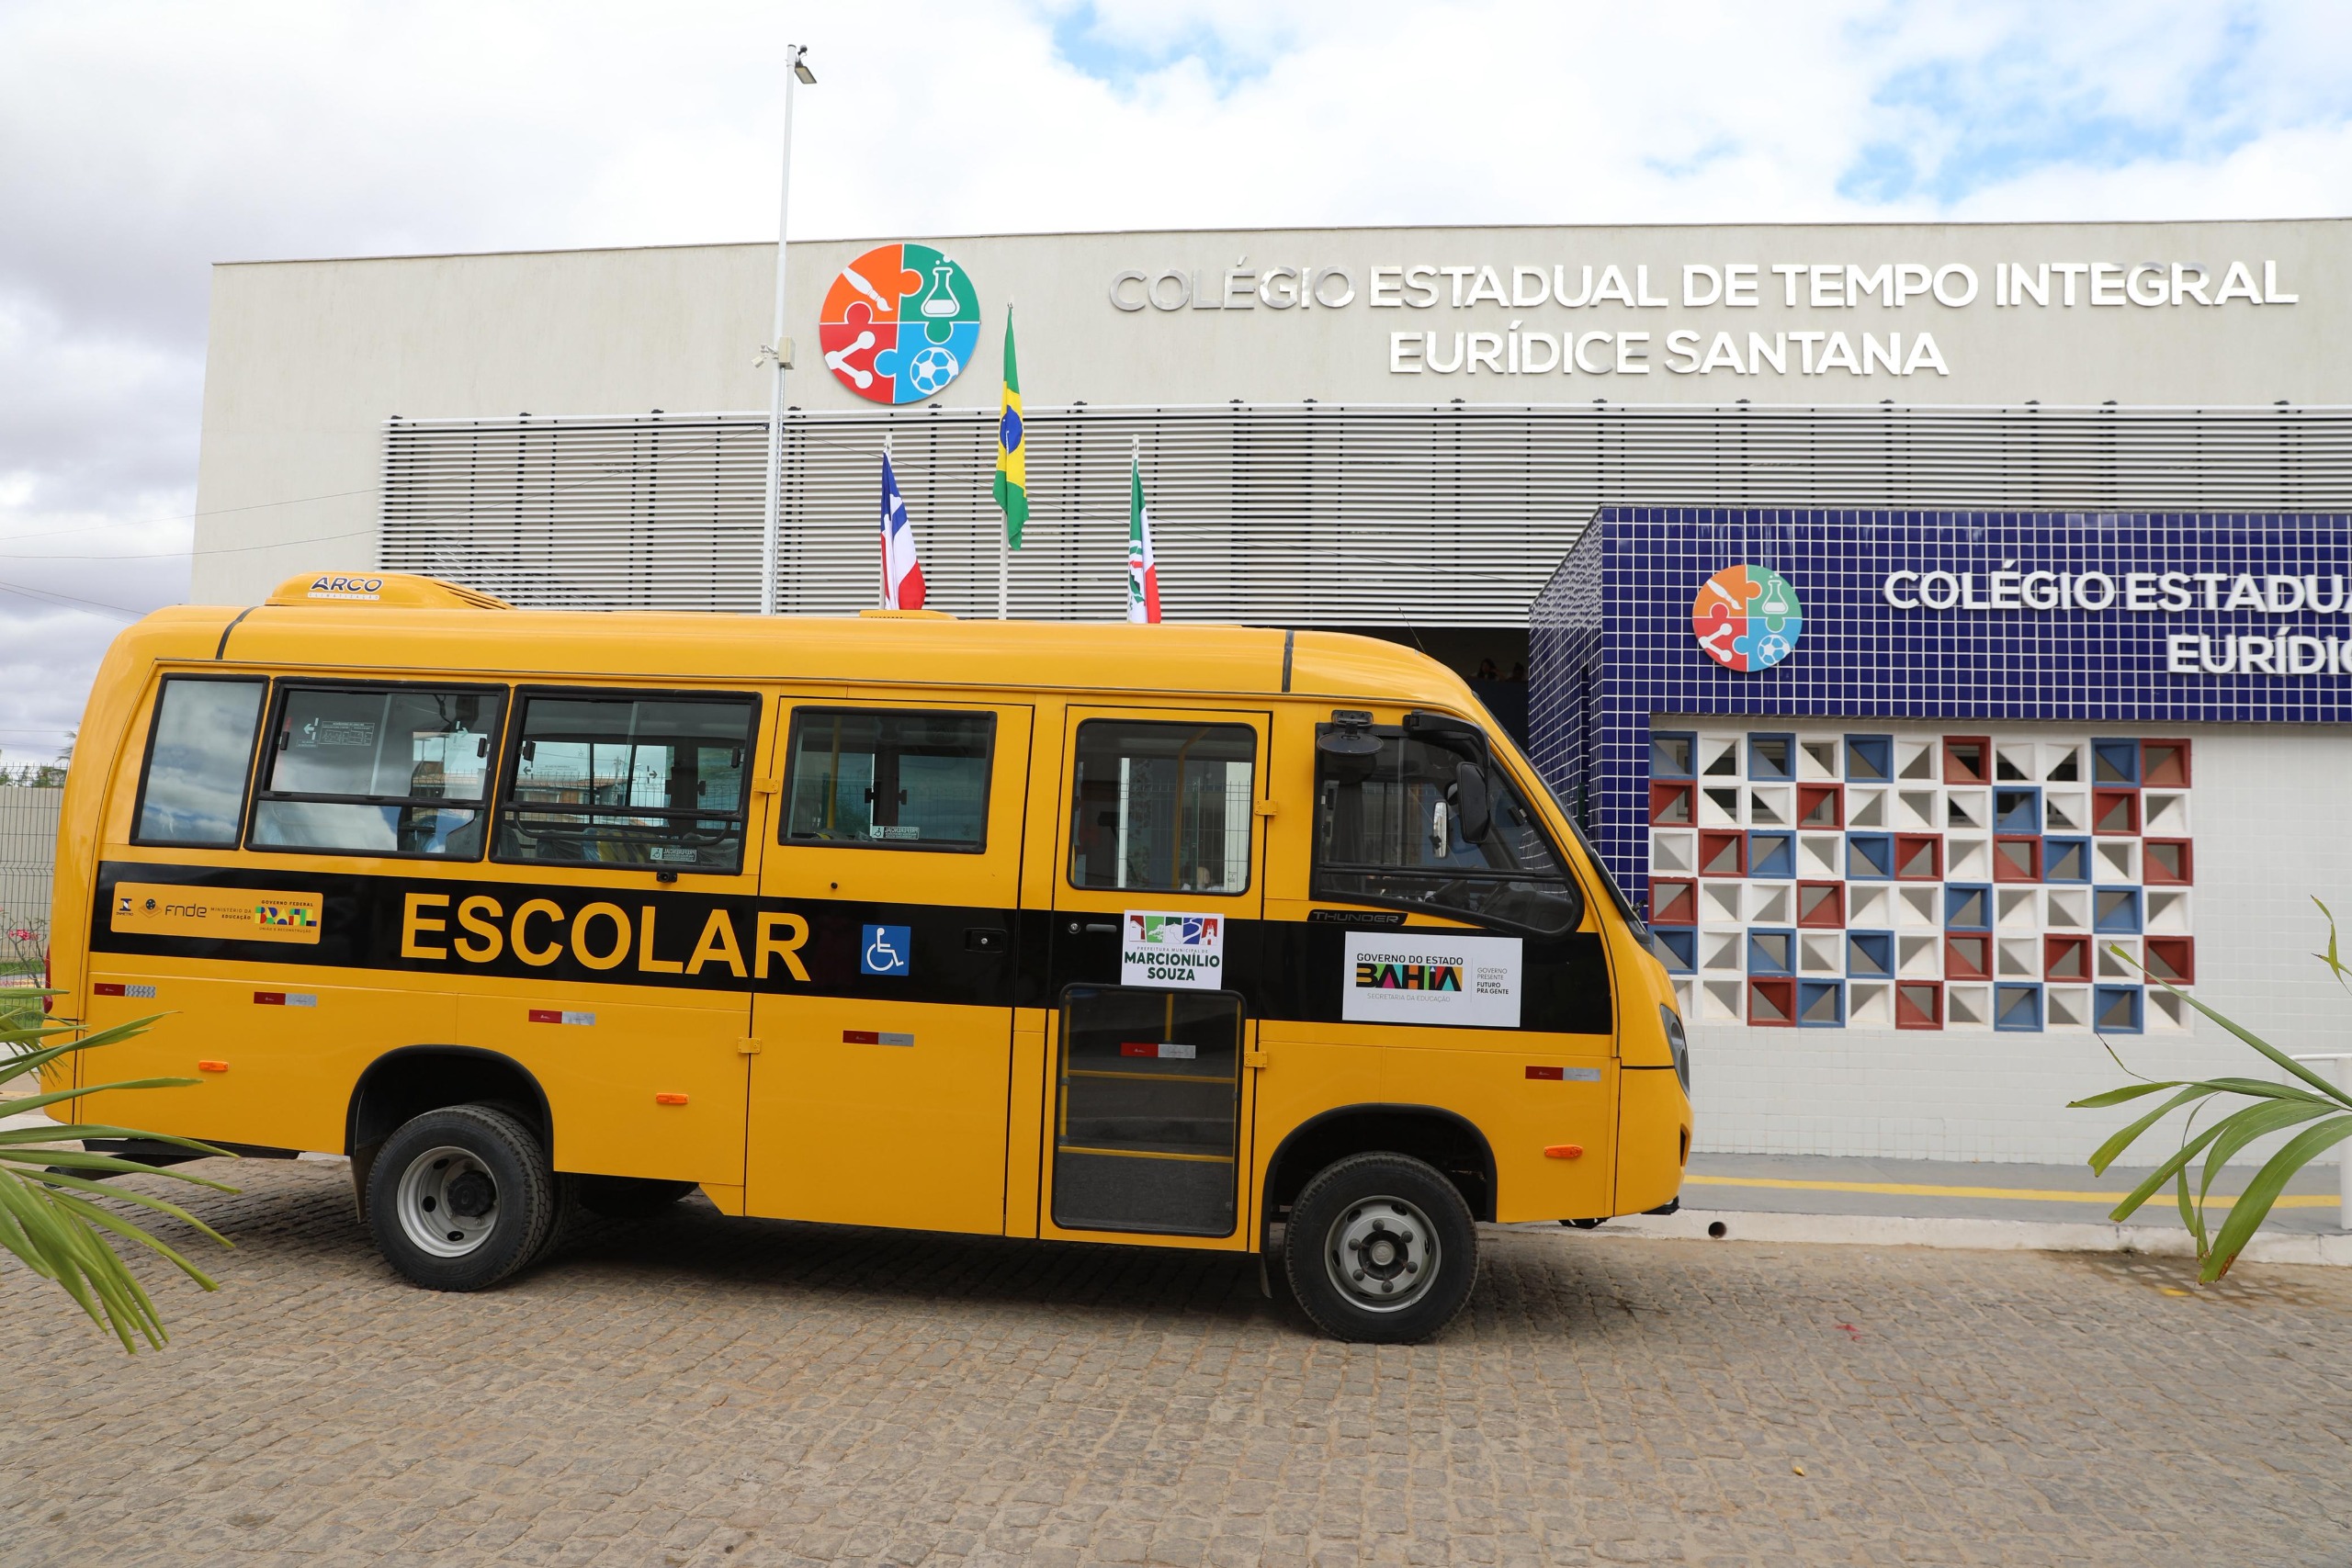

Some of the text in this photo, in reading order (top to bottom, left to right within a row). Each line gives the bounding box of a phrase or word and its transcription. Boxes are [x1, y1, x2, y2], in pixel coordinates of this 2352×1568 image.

[1109, 255, 2300, 311] COLÉGIO ESTADUAL DE TEMPO INTEGRAL
[1390, 321, 1950, 376] EURÍDICE SANTANA
[310, 576, 383, 592] ARCO
[1883, 559, 2352, 615] COLÉGIO ESTADU
[254, 906, 317, 927] BRASIL
[1312, 910, 1399, 923] THUNDER
[401, 892, 811, 982] ESCOLAR
[1356, 953, 1464, 965] GOVERNO DO ESTADO
[1147, 966, 1195, 981] SOUZA
[1356, 963, 1463, 992] BAHIA
[1476, 966, 1508, 975] GOVERNO
[1366, 992, 1405, 1001] SECRETARIA
[1417, 995, 1451, 1003] EDUCAÇÃO
